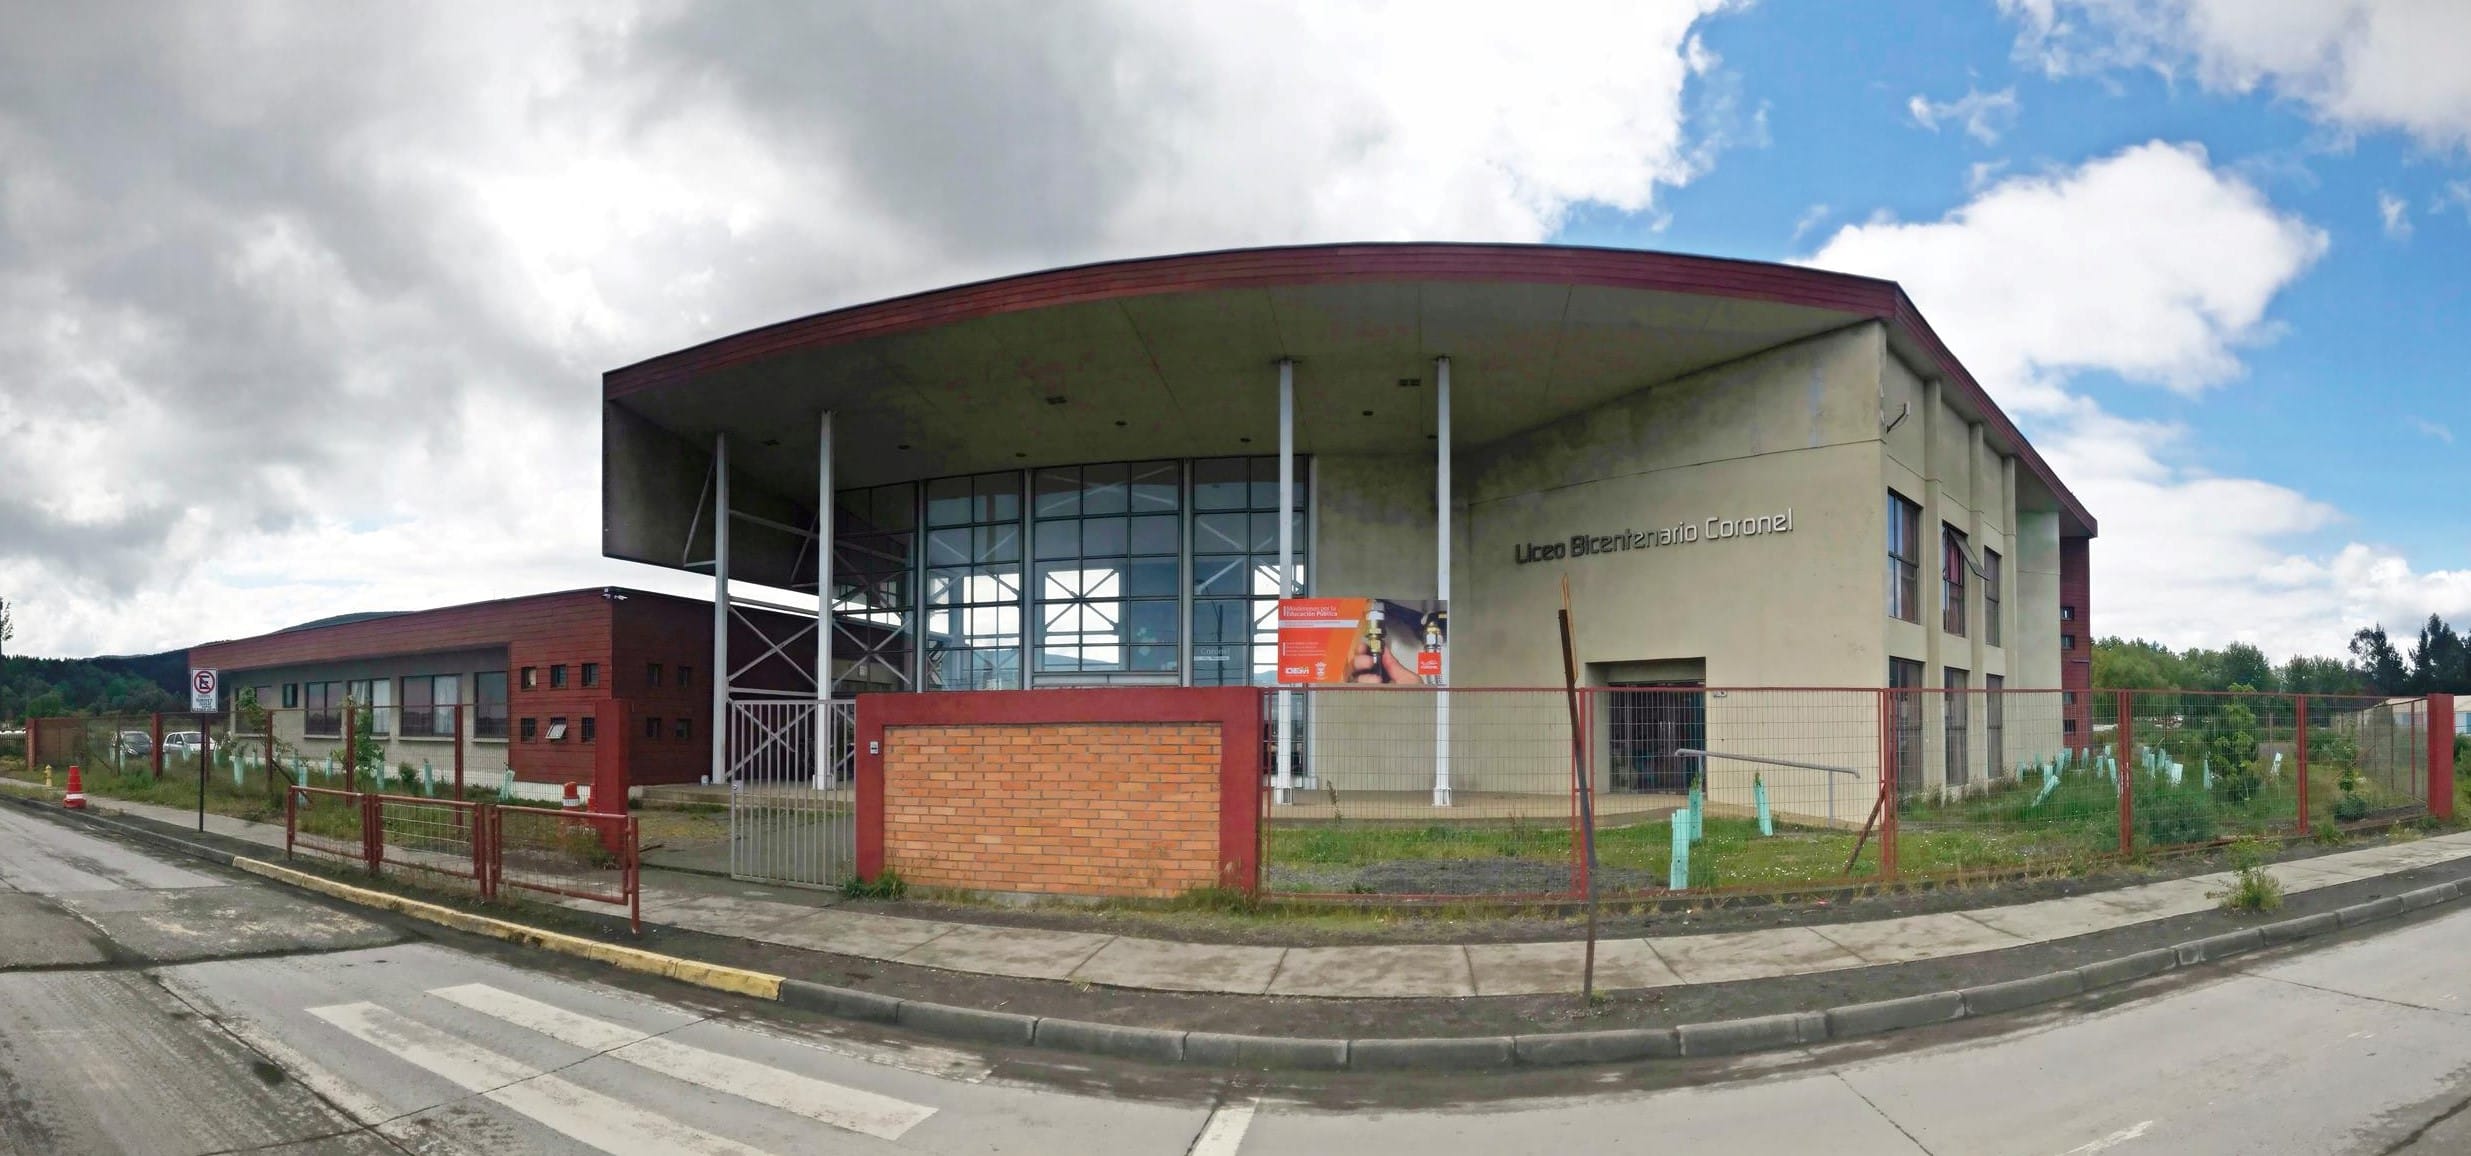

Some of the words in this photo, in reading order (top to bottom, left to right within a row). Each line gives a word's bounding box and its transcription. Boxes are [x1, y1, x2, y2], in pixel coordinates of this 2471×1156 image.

[1515, 541, 1566, 564] Liceo
[1571, 521, 1698, 557] Bicentenario
[1706, 507, 1794, 540] Coronel
